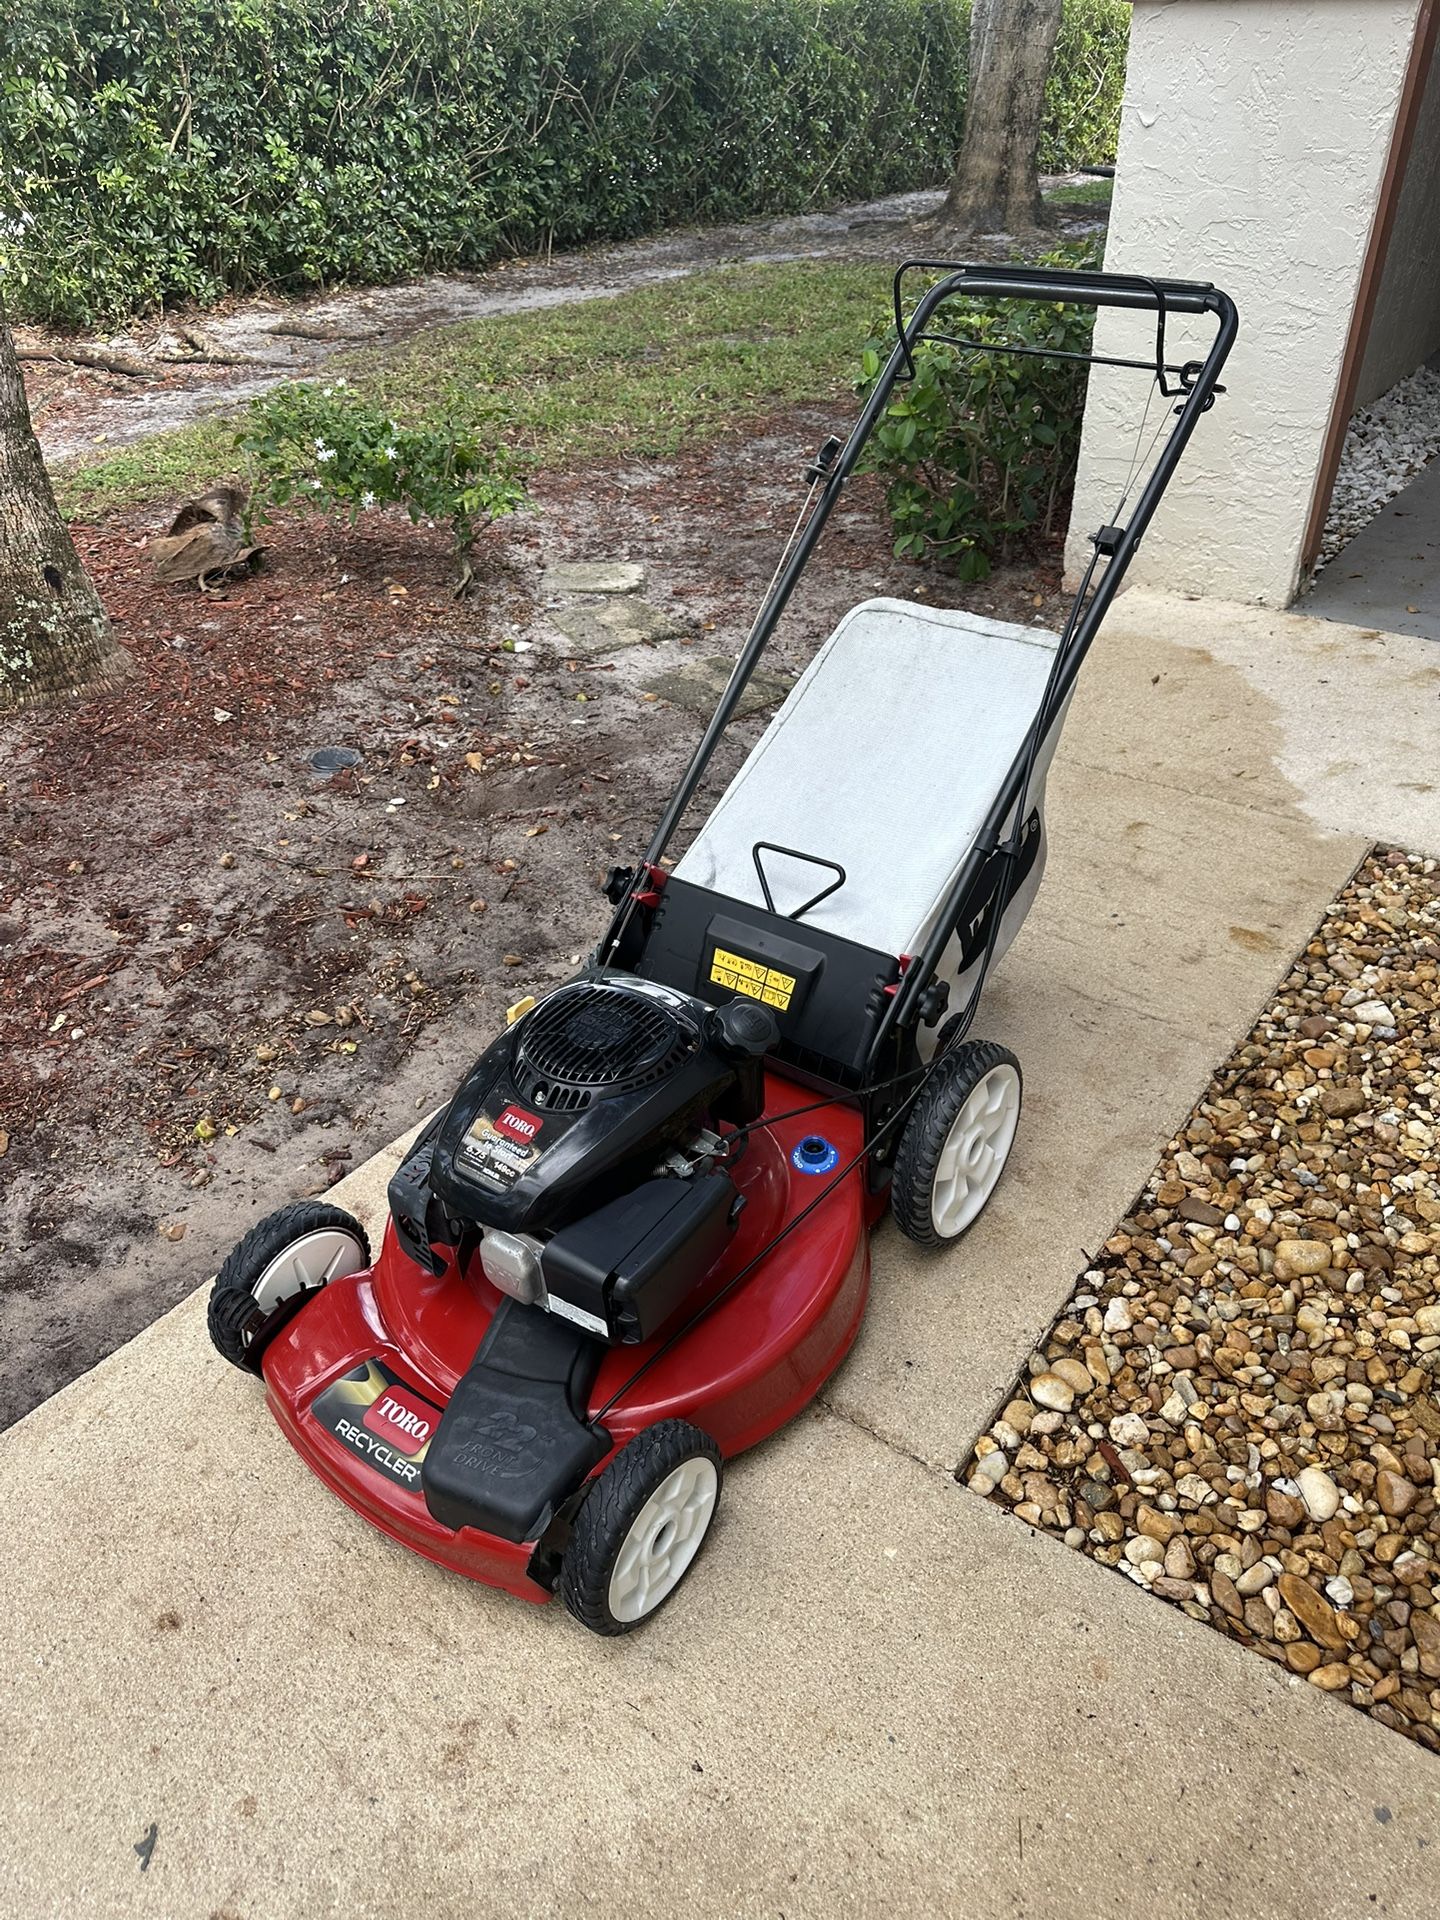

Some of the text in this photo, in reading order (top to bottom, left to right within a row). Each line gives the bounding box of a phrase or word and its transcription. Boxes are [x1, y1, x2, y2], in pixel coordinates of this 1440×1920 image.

[502, 1112, 534, 1137] TORO
[466, 1146, 487, 1159] 6.75
[481, 1128, 529, 1157] Guaranteed
[484, 1140, 493, 1150] to
[492, 1144, 513, 1160] Start
[494, 1161, 516, 1178] 149cc
[377, 1397, 430, 1440] TORO
[335, 1418, 418, 1483] RECYCLER
[461, 1441, 517, 1464] FRONT
[453, 1453, 501, 1477] DRIVE
